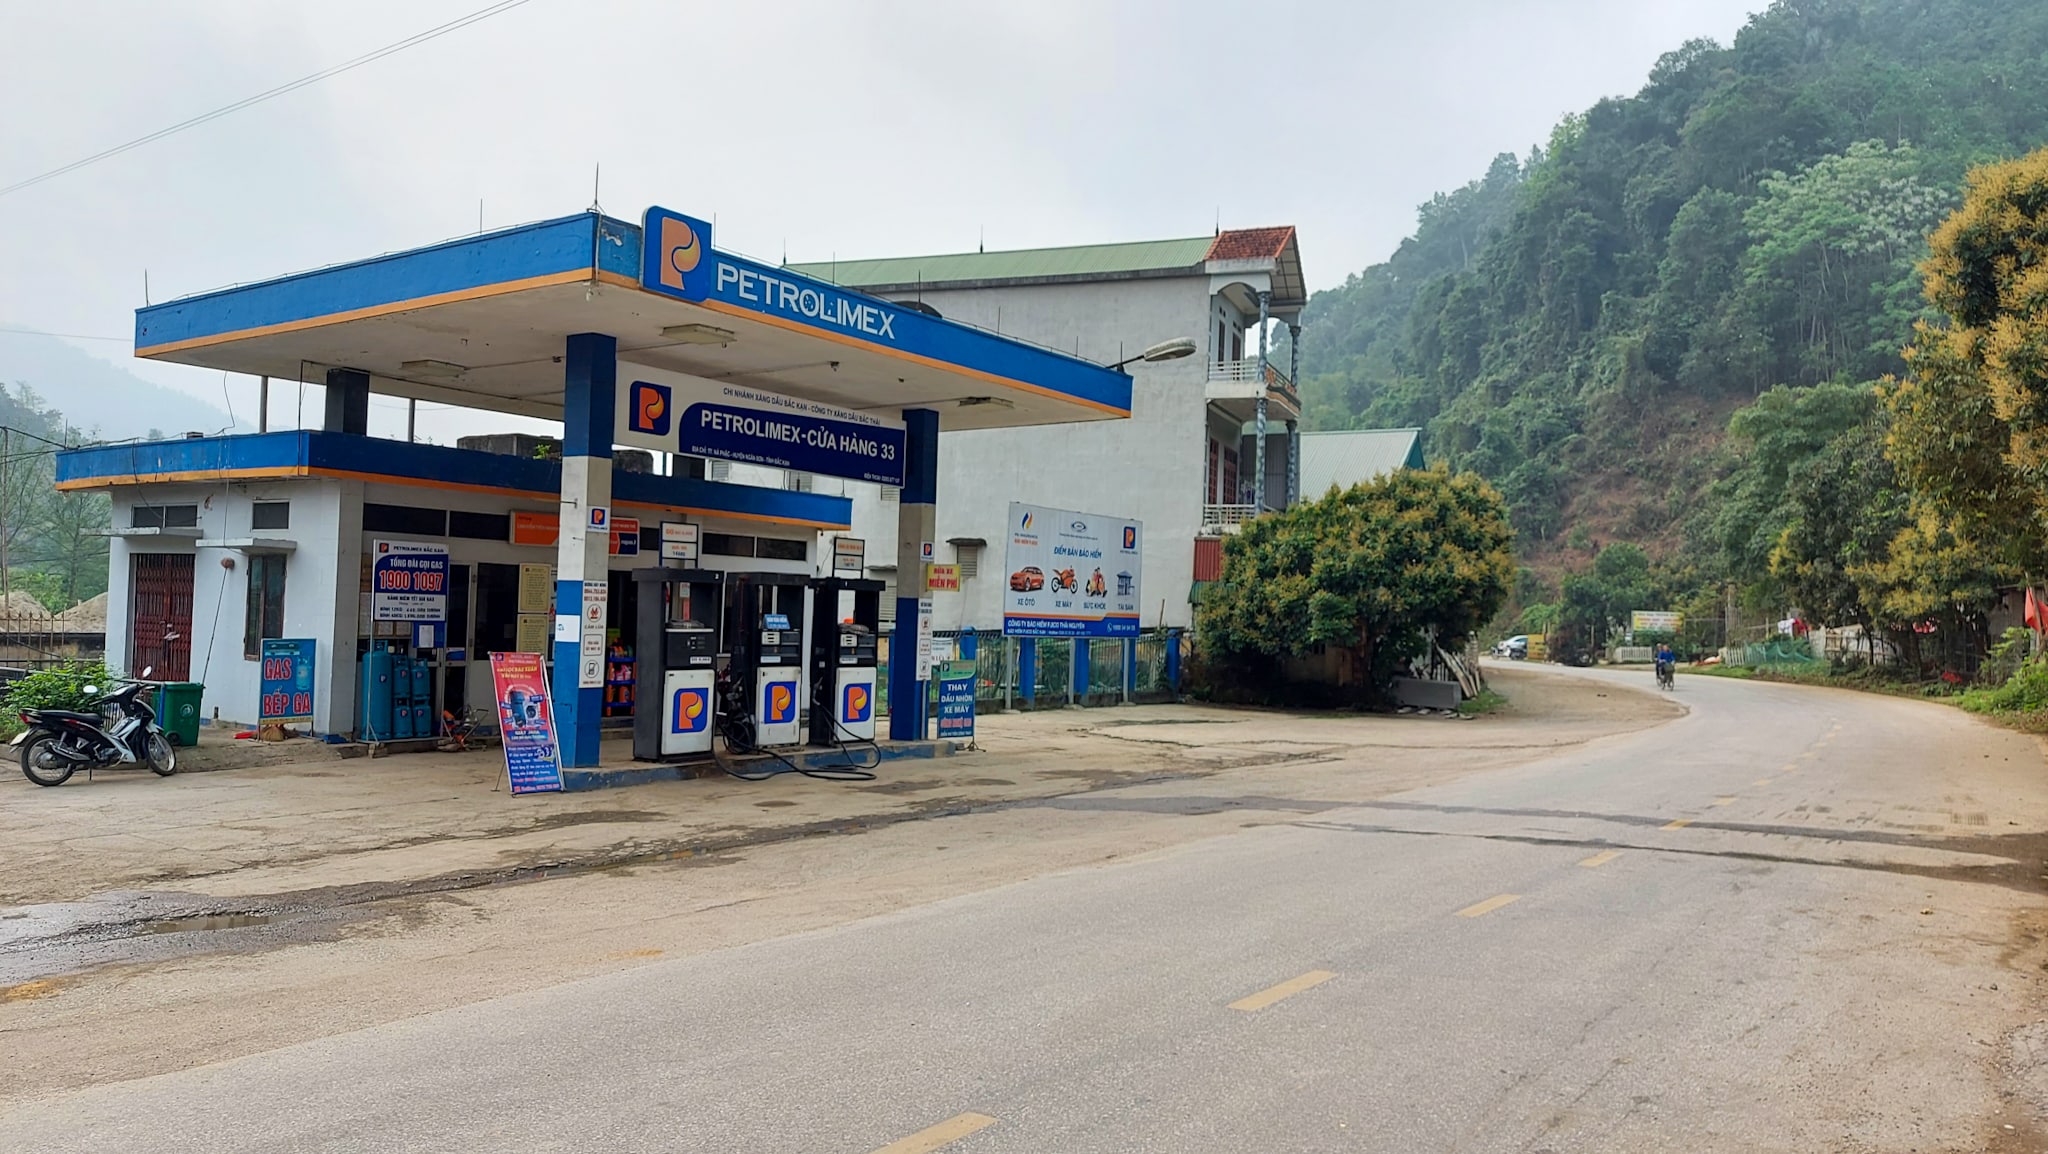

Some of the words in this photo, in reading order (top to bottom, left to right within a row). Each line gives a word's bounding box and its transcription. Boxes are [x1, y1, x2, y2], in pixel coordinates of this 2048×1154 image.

[717, 262, 895, 339] PETROLIMEX
[840, 432, 878, 457] HÀNG
[881, 443, 895, 460] 33
[419, 560, 430, 571] GỌI
[431, 560, 443, 570] GAS
[379, 570, 410, 590] 1900
[413, 571, 443, 591] 1097
[946, 576, 958, 589] PHÍ
[1017, 598, 1024, 606] XE
[1062, 600, 1072, 608] MÁY
[264, 657, 292, 680] GAS
[947, 683, 968, 692] THAY
[263, 685, 290, 716] BẾP
[293, 692, 311, 714] GA
[941, 692, 955, 703] DẦU
[944, 706, 953, 714] XE
[954, 705, 970, 714] MÁY
